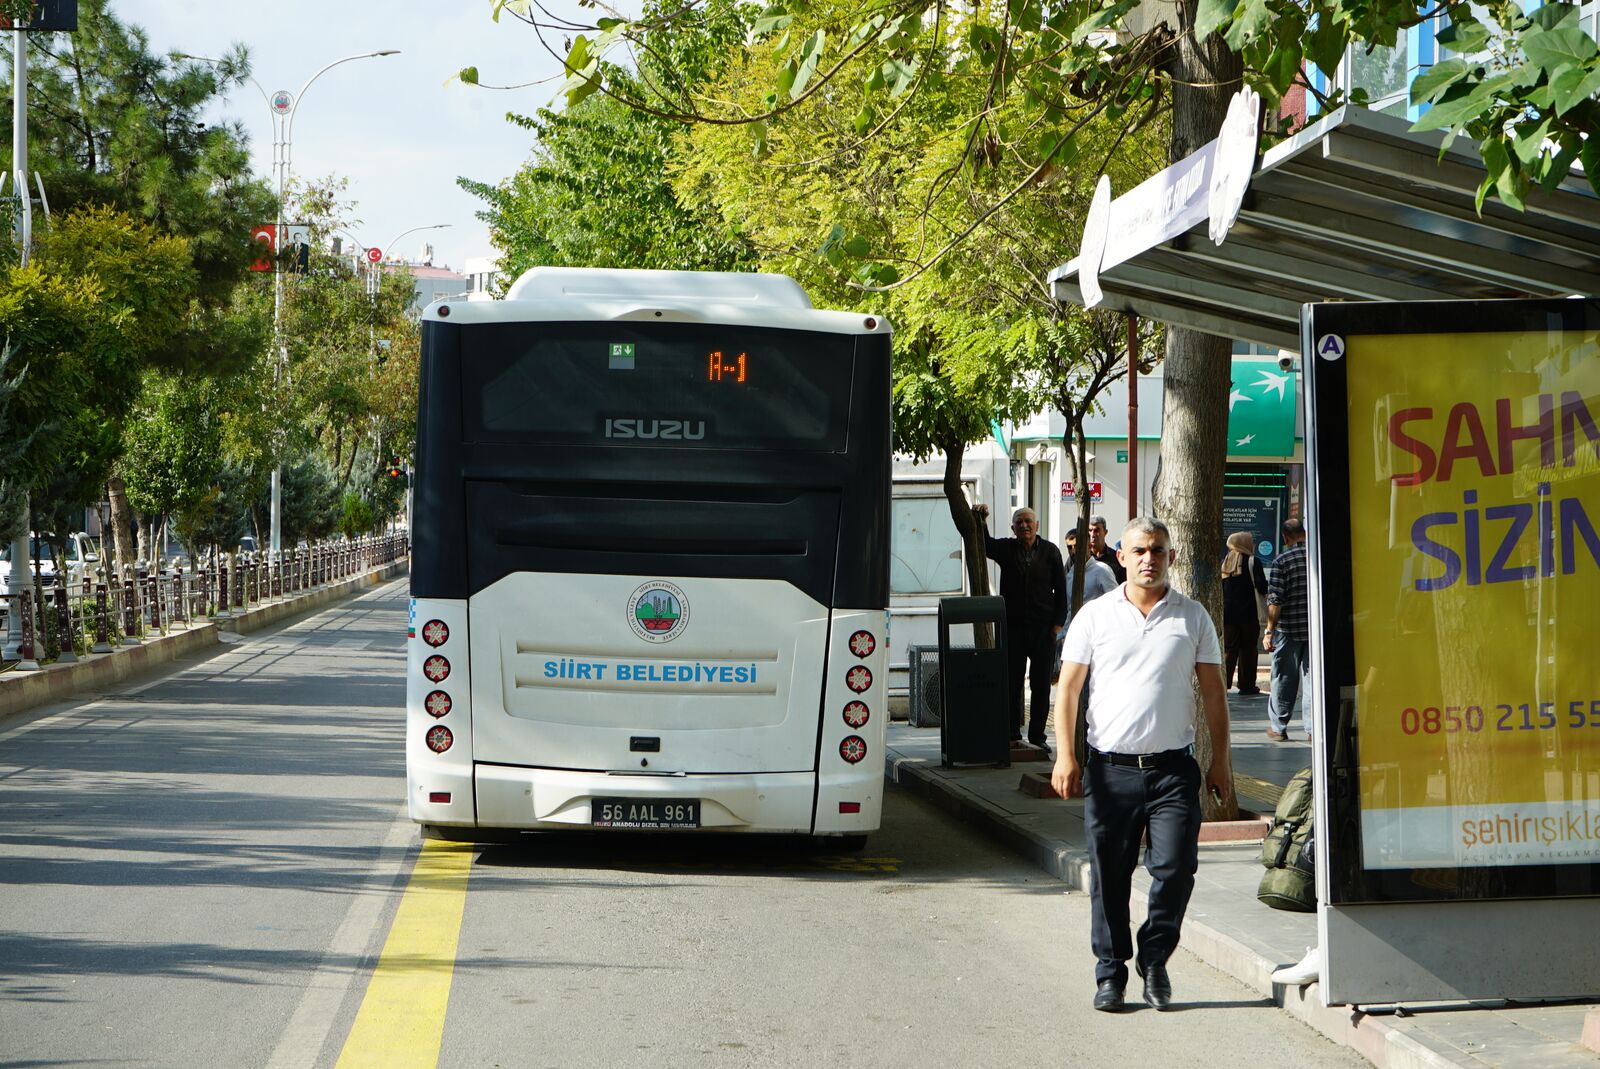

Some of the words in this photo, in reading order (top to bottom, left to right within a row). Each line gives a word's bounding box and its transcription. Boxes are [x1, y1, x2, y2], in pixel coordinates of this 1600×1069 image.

[1321, 335, 1341, 354] A
[709, 351, 745, 382] A-1
[605, 418, 705, 440] ISUZU
[543, 658, 608, 681] SİİRT
[616, 662, 757, 684] BELEDİYESİ
[1400, 705, 1485, 736] 0850
[1495, 702, 1558, 731] 215
[602, 804, 623, 821] 56
[629, 804, 659, 821] AAL
[664, 804, 694, 821] 961
